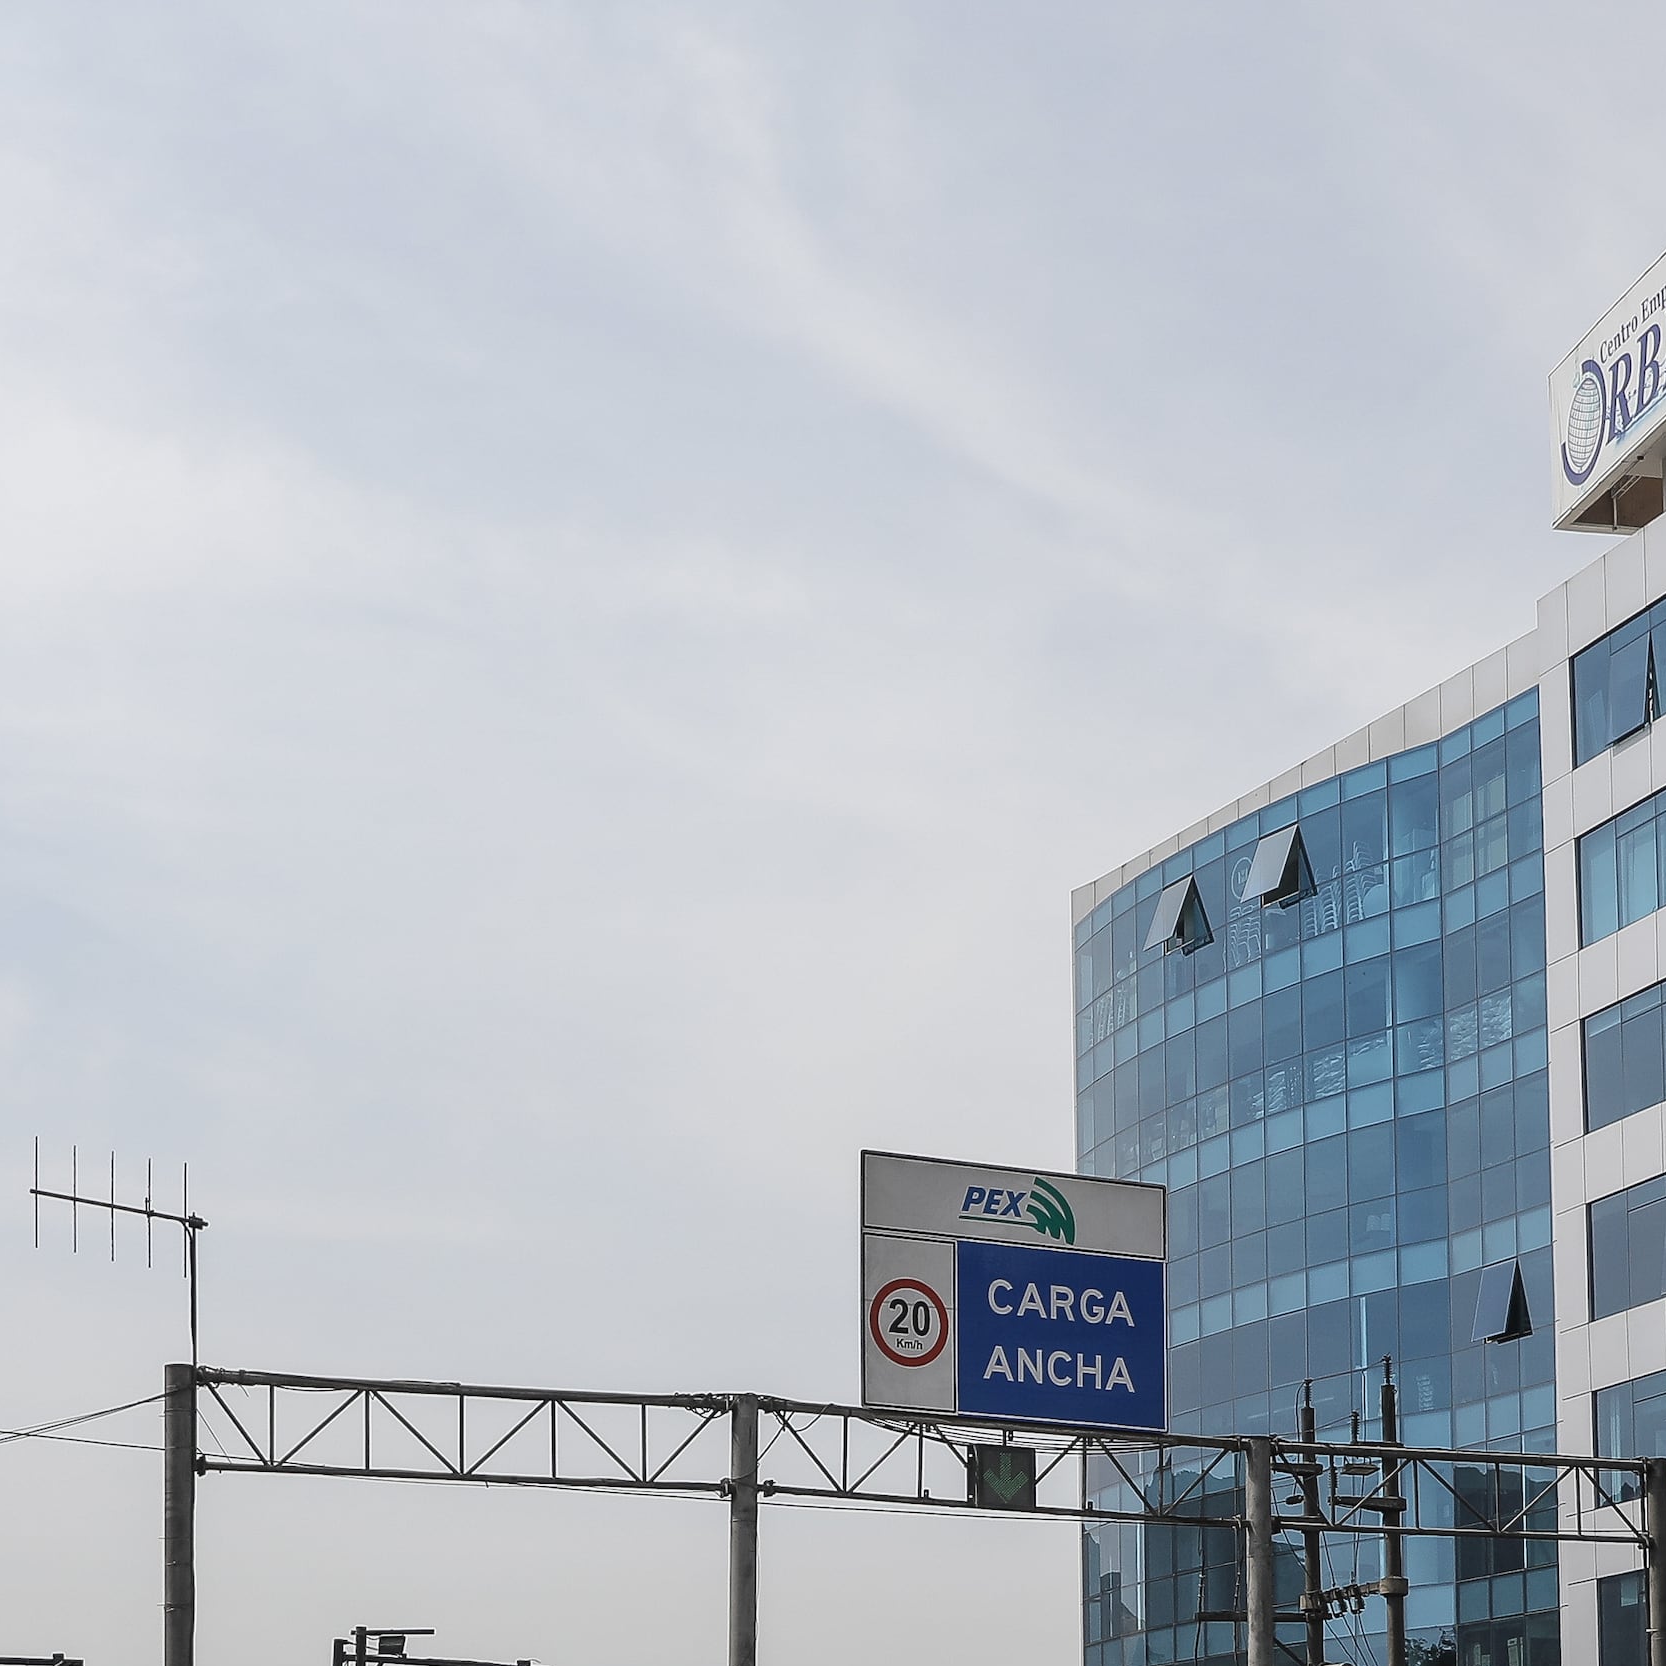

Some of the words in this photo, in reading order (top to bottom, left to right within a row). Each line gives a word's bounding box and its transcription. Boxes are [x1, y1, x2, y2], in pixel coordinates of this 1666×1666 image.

[1598, 314, 1639, 365] Centro
[961, 1185, 1029, 1220] PEX
[888, 1298, 931, 1336] 20
[987, 1278, 1136, 1328] CARGA
[895, 1337, 924, 1352] Km/h
[982, 1344, 1136, 1393] ANCHA
